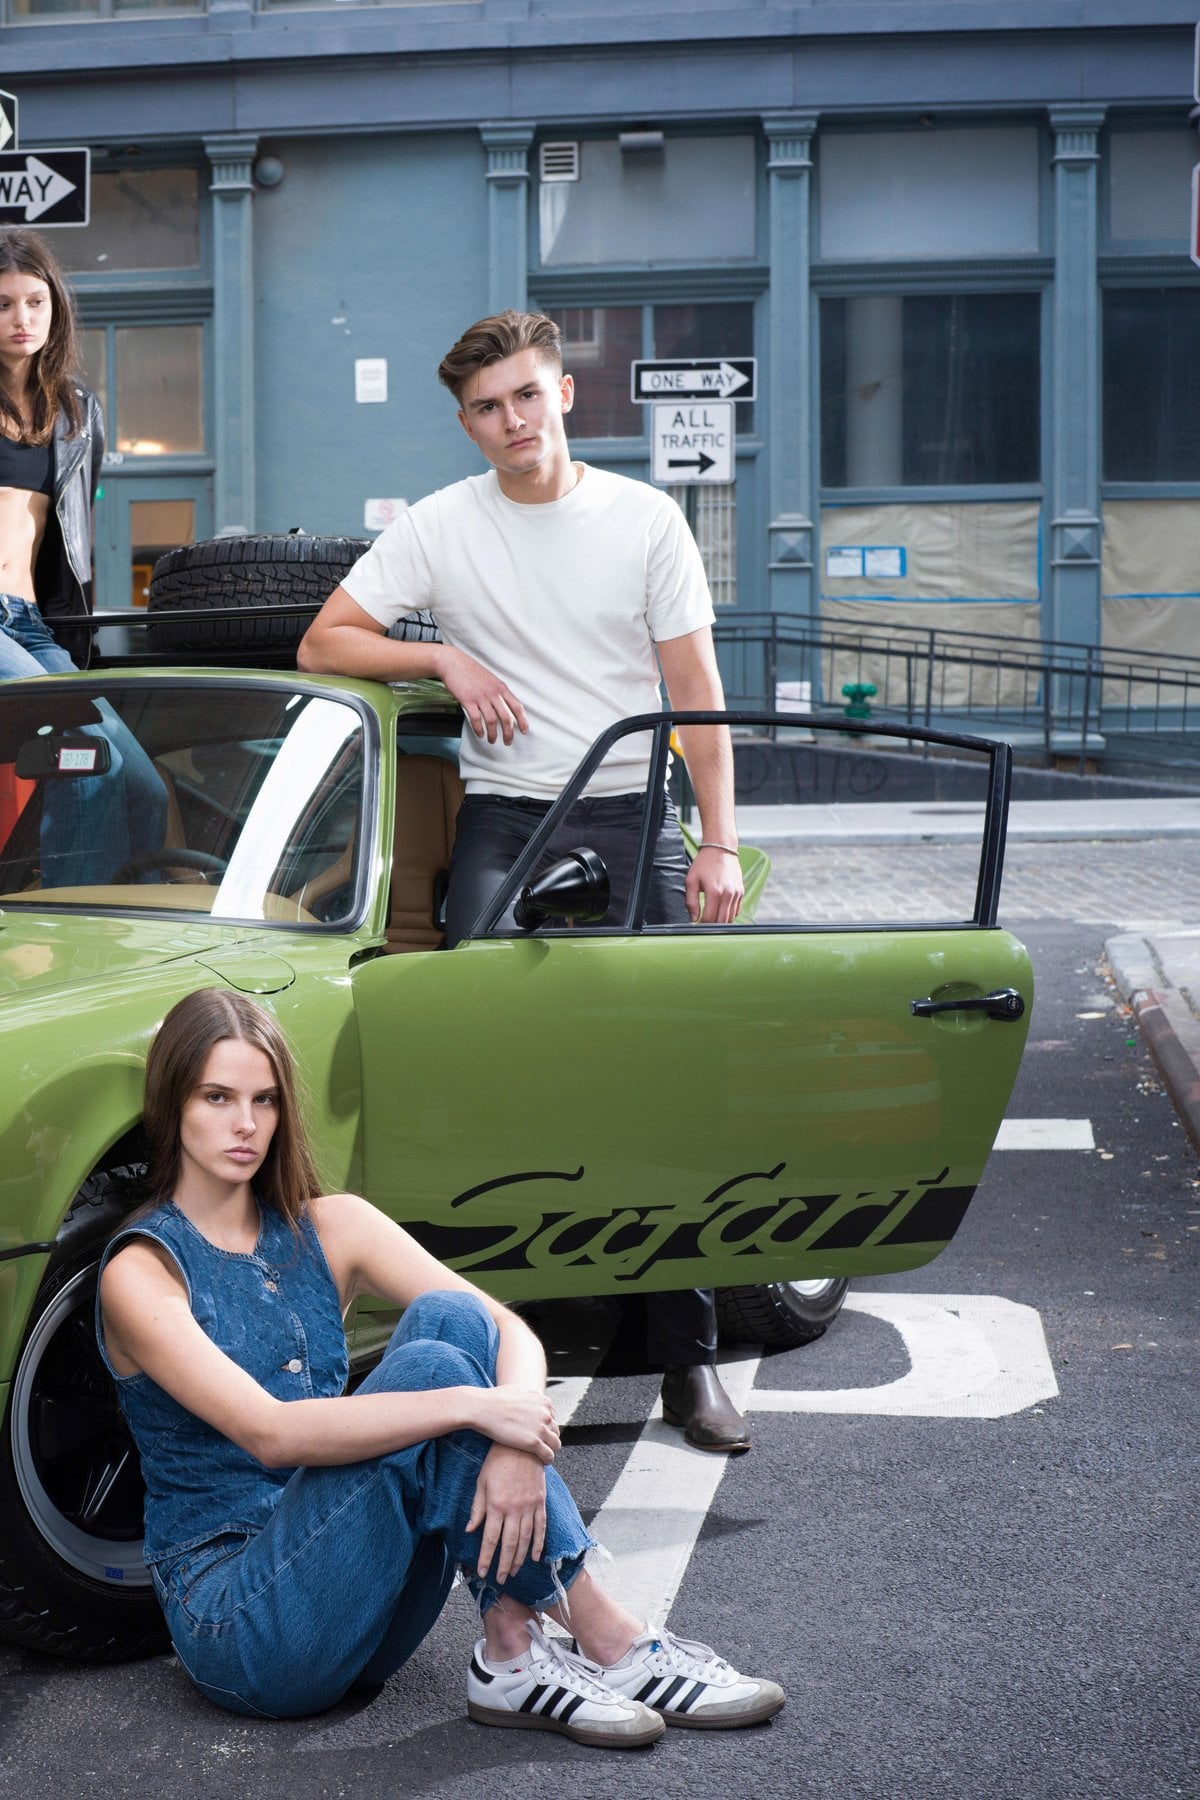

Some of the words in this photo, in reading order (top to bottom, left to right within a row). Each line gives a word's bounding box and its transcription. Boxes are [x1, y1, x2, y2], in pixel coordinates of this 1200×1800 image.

[650, 373, 684, 389] ONE
[701, 373, 736, 387] WAY
[672, 409, 715, 428] ALL
[661, 433, 725, 449] TRAFFIC
[430, 1162, 952, 1282] Safari
